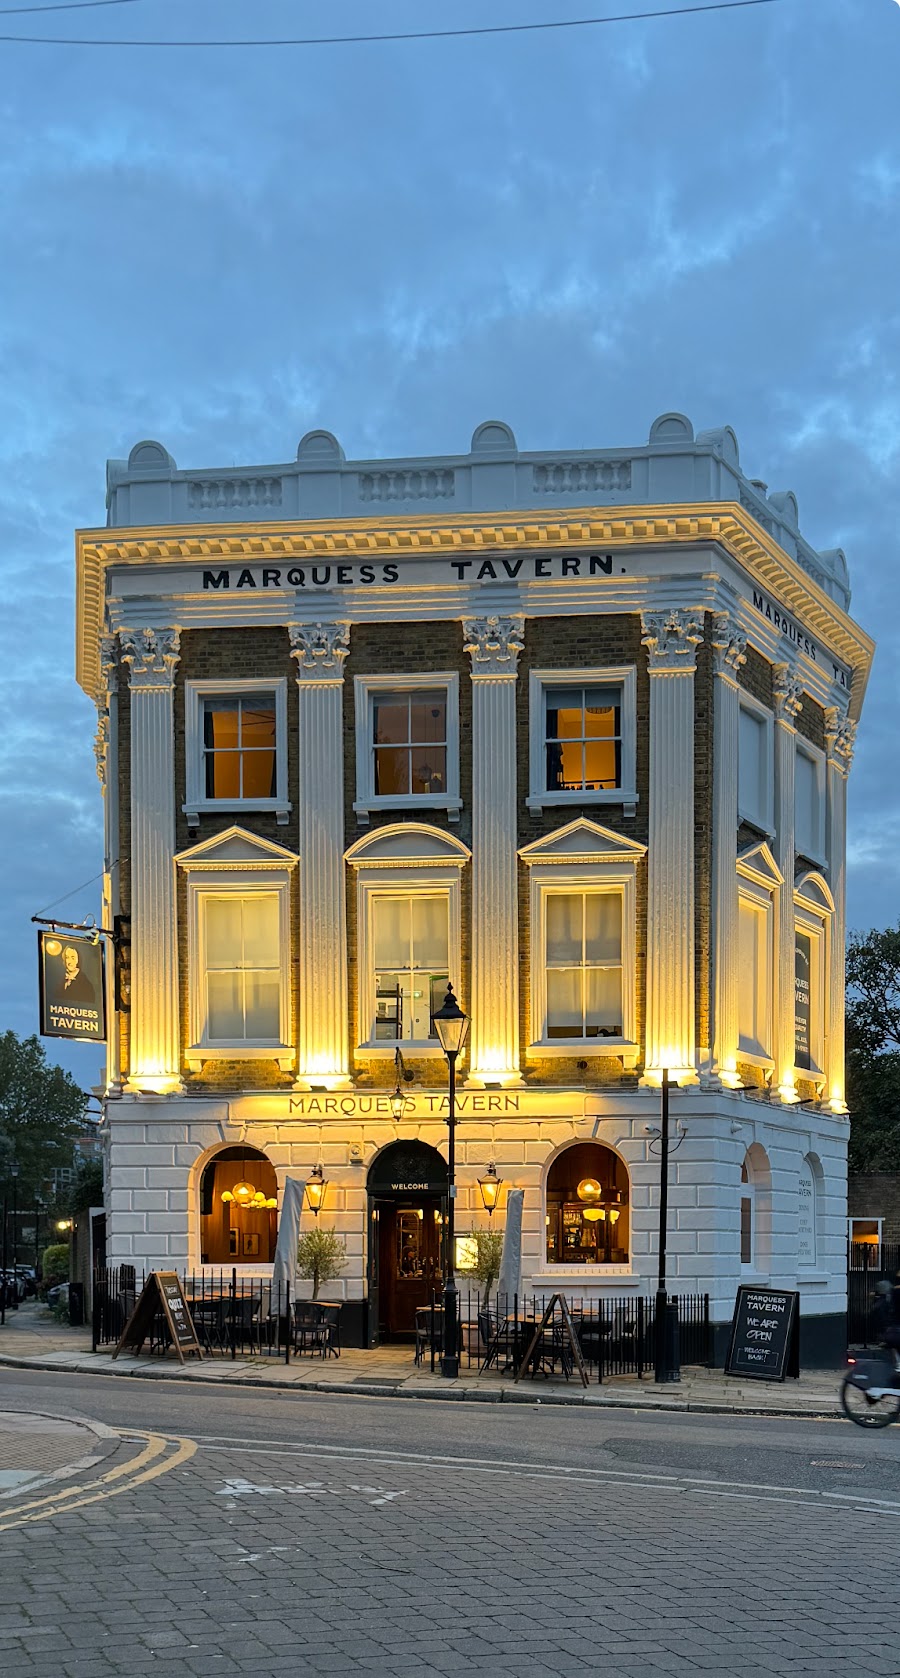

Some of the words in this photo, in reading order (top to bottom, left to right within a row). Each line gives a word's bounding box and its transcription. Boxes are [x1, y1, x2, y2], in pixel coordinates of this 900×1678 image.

[202, 563, 399, 590] MARQUESS
[451, 554, 627, 580] TAVERN.
[753, 591, 816, 660] MARQUESS
[50, 1004, 98, 1019] MARQUESS
[50, 1016, 99, 1032] TAVERN
[289, 1096, 416, 1116] MARQUES
[747, 1295, 786, 1304] MARQUESS
[747, 1302, 785, 1313] TAVERN
[747, 1317, 759, 1326] WE
[760, 1319, 779, 1329] ARE
[746, 1330, 773, 1341] OPEN
[744, 1347, 771, 1355] WELCOME
